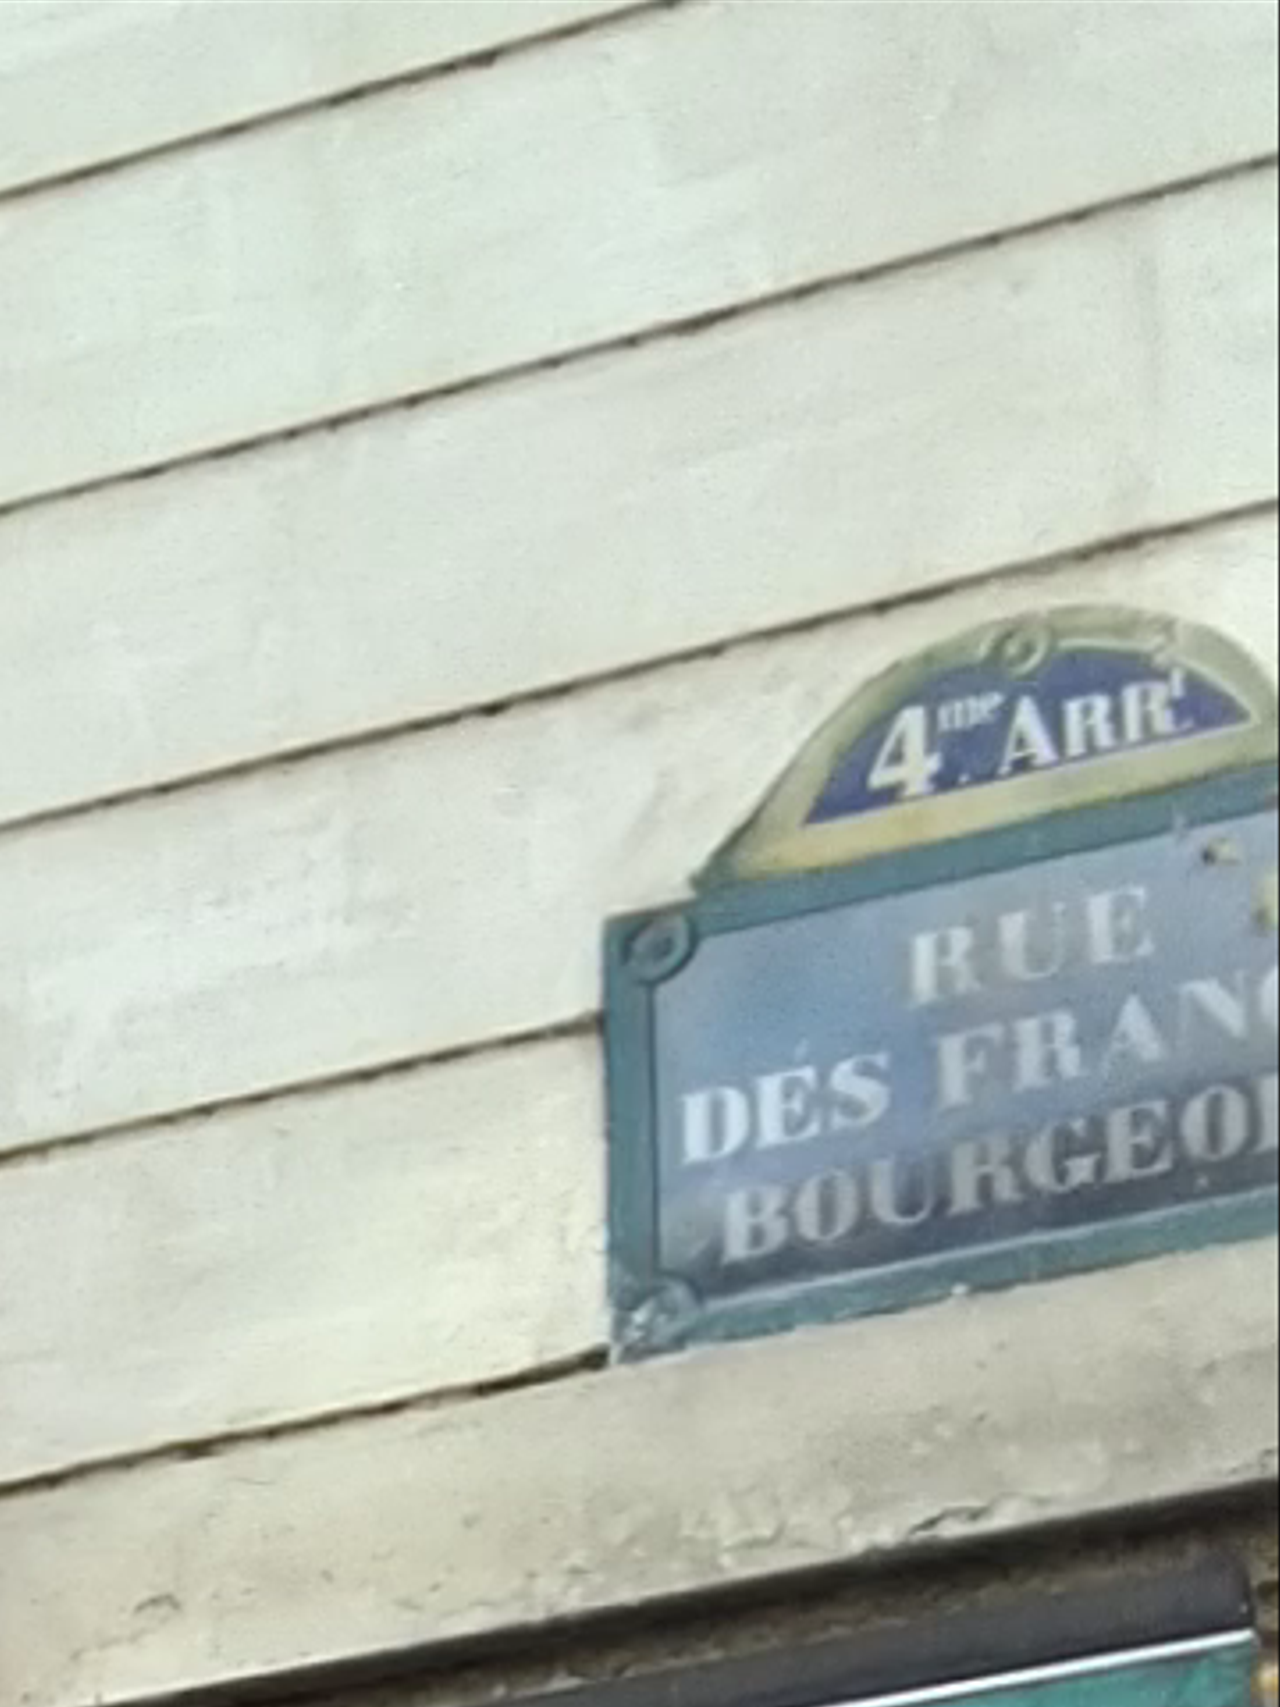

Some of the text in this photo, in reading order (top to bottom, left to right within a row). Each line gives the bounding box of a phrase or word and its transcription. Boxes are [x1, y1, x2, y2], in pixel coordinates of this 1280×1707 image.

[910, 886, 1156, 1005] RUE
[681, 962, 1279, 1165] DES FRAN
